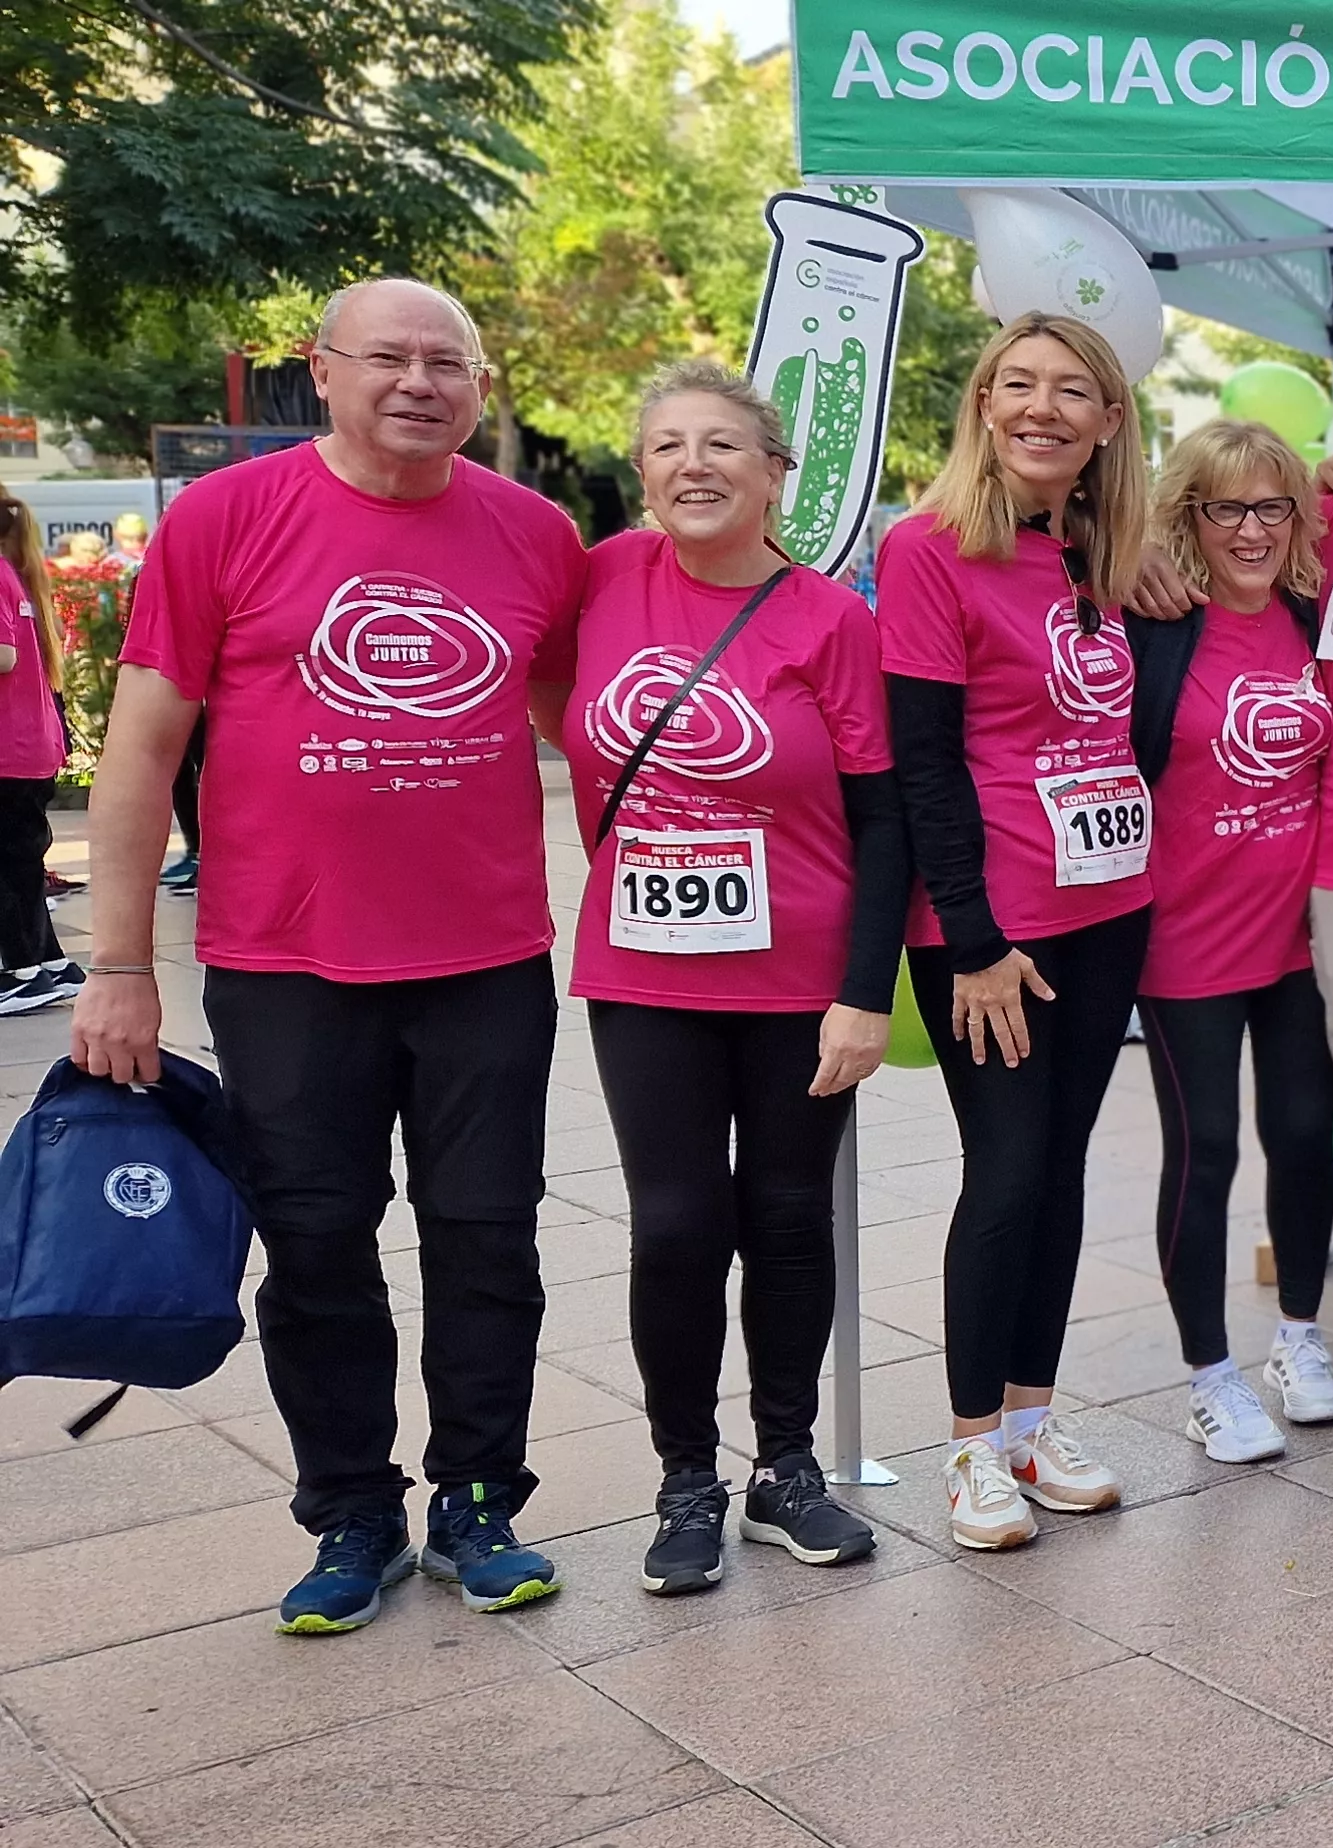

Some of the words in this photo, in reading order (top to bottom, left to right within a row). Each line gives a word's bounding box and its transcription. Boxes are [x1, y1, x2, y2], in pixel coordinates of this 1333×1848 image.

[370, 647, 430, 661] JUNTOS
[1061, 791, 1105, 807] CONTRA
[1106, 789, 1115, 800] EL
[1070, 803, 1144, 851] 1889
[652, 846, 693, 855] HUESCA
[624, 852, 663, 867] CONTRA
[665, 856, 682, 867] EL
[684, 853, 744, 867] CÁNCER
[622, 872, 748, 918] 1890
